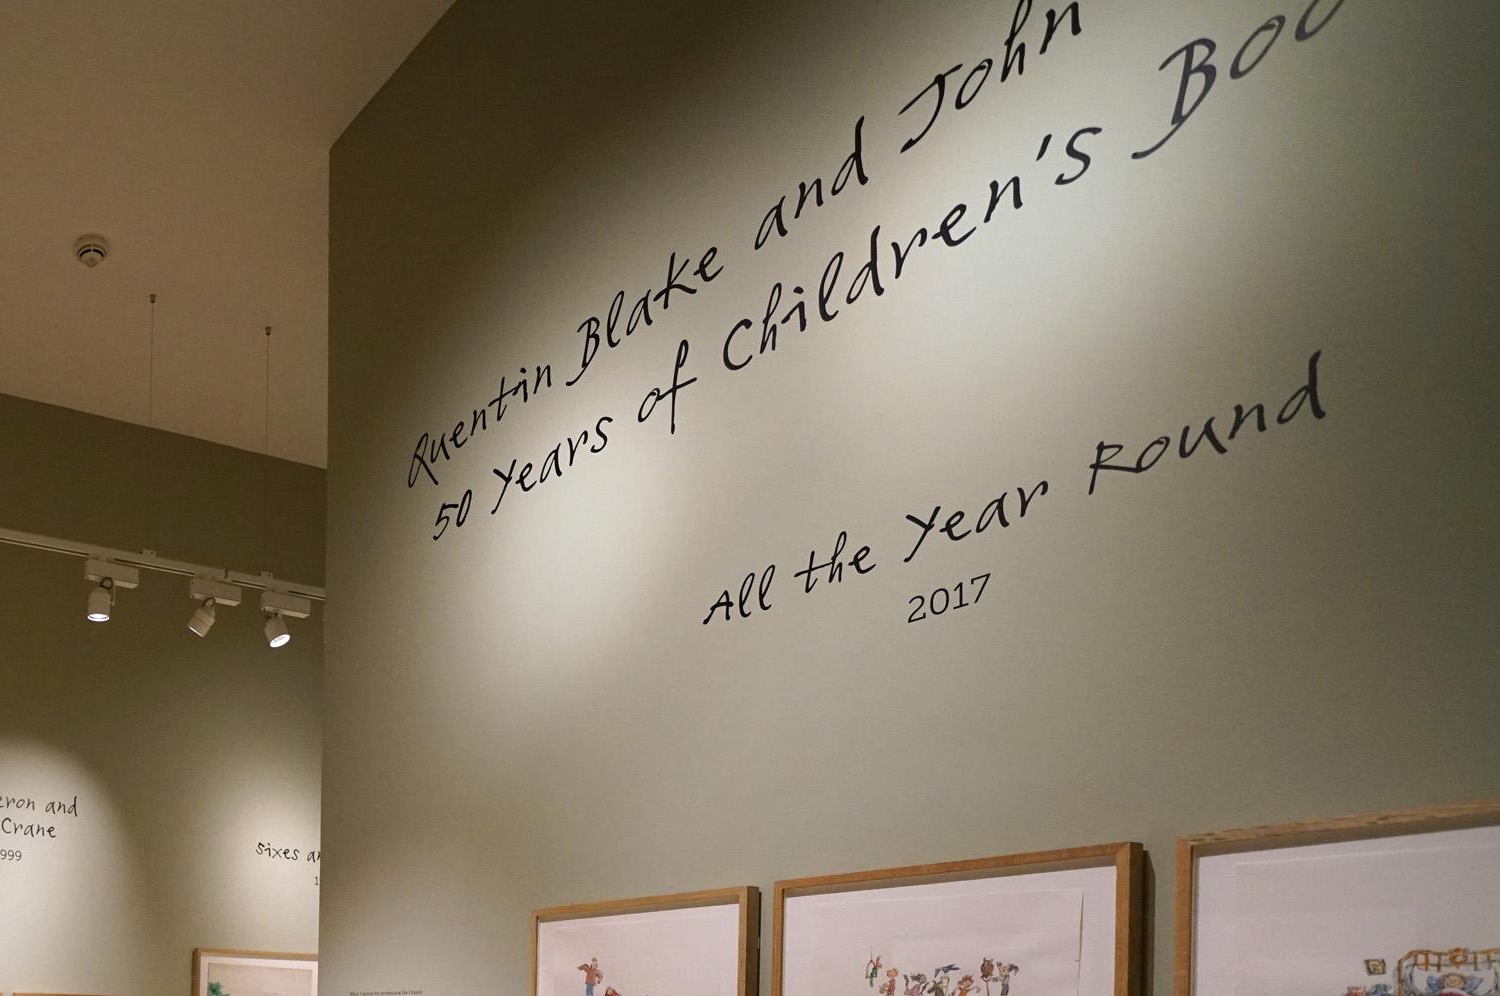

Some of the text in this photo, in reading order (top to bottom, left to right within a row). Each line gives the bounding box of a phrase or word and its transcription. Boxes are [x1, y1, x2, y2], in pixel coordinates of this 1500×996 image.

[407, 0, 1083, 489] Quentin Blake and John
[432, 488, 473, 542] 50
[490, 415, 614, 516] Years
[637, 338, 698, 436] of
[722, 126, 1103, 372] Children's
[702, 349, 1327, 626] All the Year Round
[907, 572, 992, 624] 2017
[1, 817, 57, 839] Crane
[44, 795, 78, 818] and
